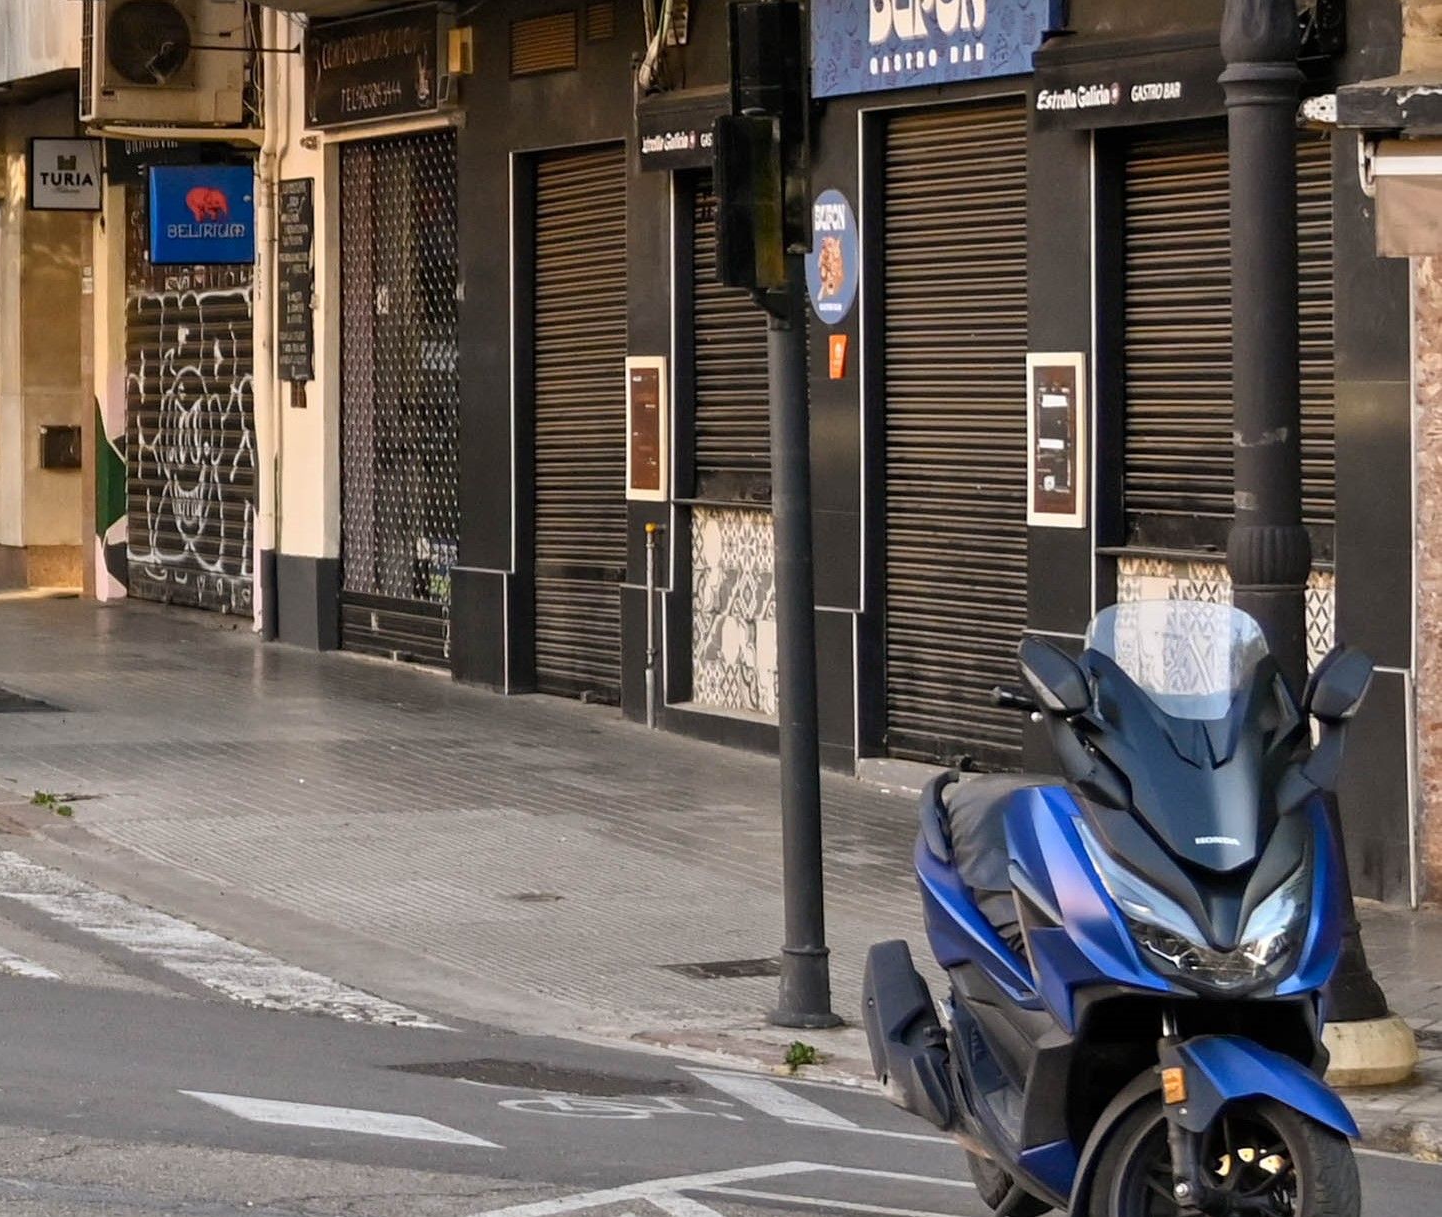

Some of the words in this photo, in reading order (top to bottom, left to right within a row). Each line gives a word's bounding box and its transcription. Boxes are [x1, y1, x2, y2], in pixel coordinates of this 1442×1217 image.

[869, 48, 938, 75] GASTRO
[950, 42, 985, 64] BAR
[1131, 83, 1163, 103] GASTRO
[1163, 81, 1181, 99] BAR
[40, 172, 93, 187] TURIA
[1195, 836, 1241, 846] HONDA
